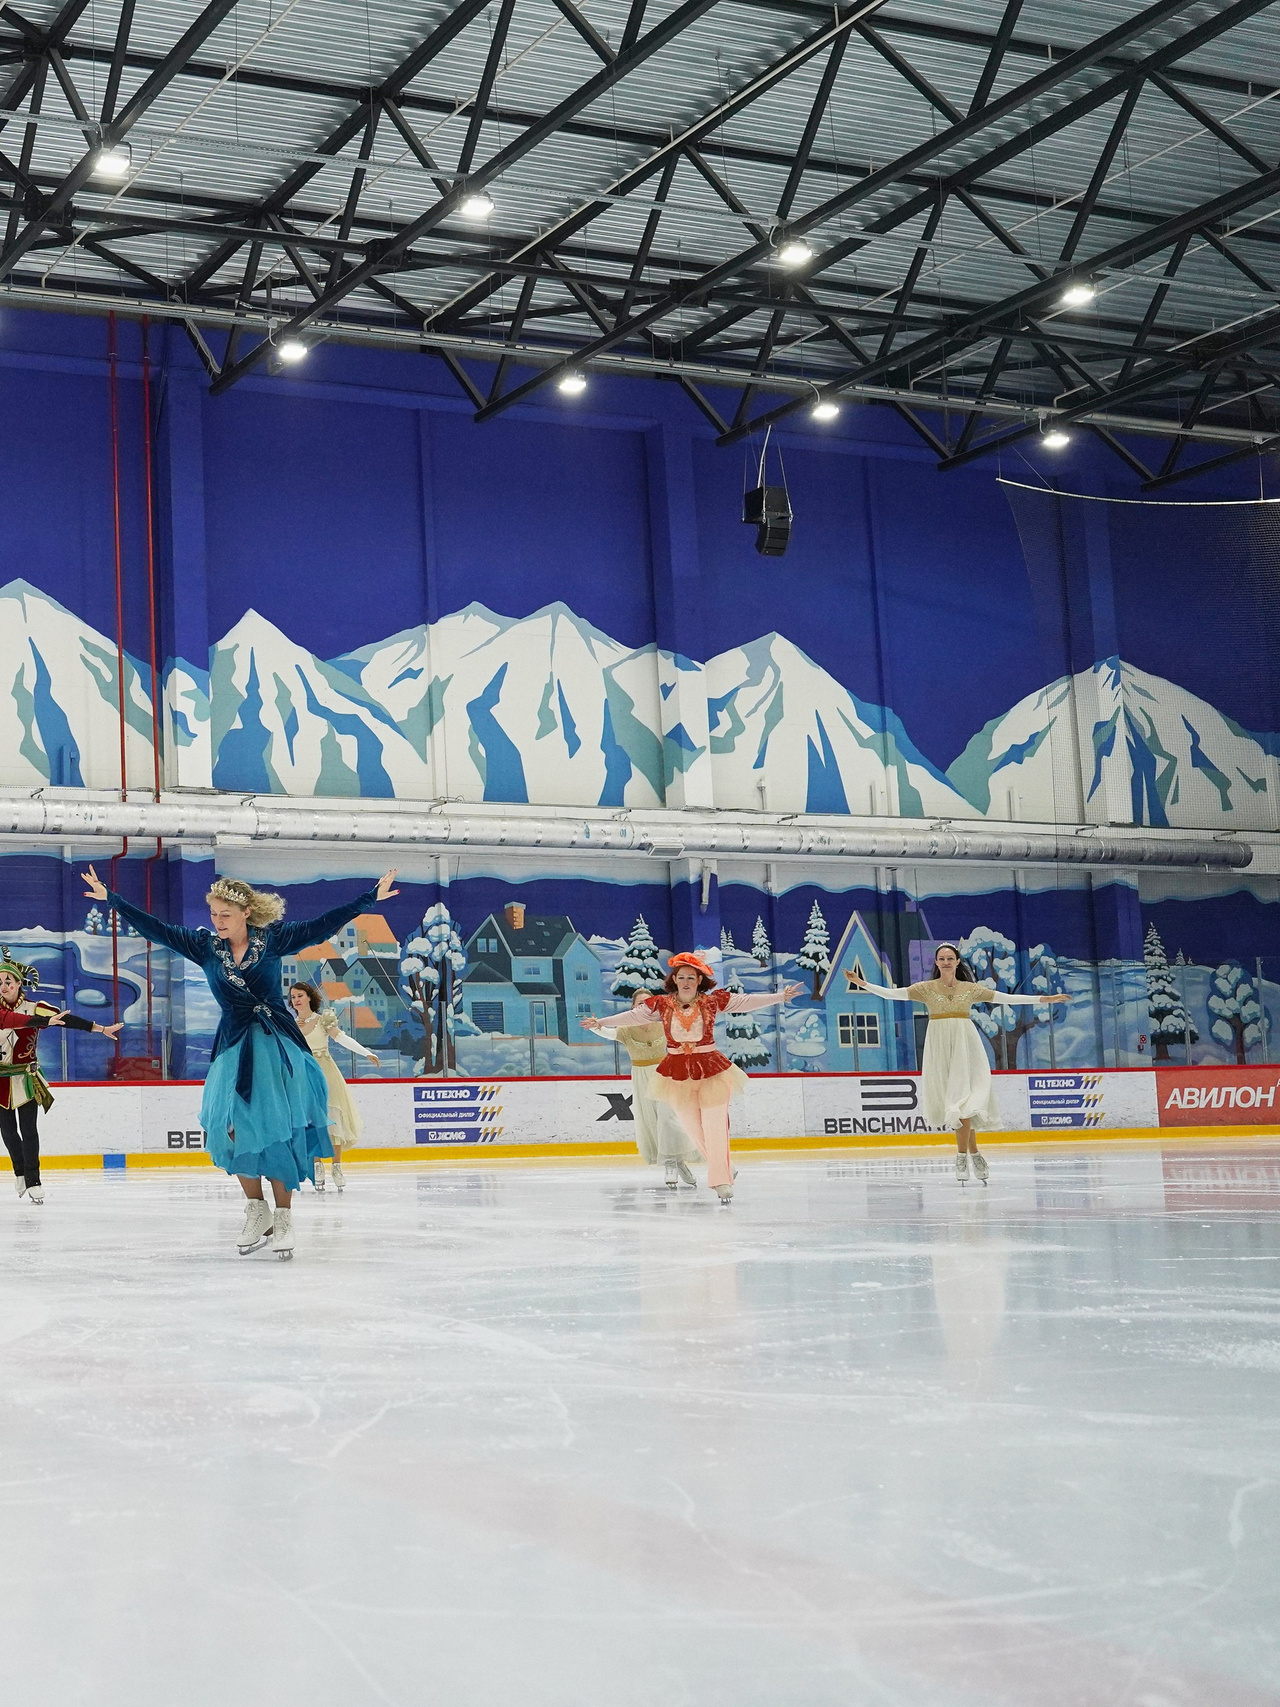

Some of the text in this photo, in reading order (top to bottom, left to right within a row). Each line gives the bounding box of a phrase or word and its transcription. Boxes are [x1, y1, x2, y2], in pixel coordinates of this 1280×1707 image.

[1046, 1079, 1075, 1087] ТЕХНО
[421, 1089, 471, 1101] ГЦ ТЕХНО
[1164, 1086, 1275, 1109] АВИЛОН
[824, 1116, 956, 1134] BENCHMA
